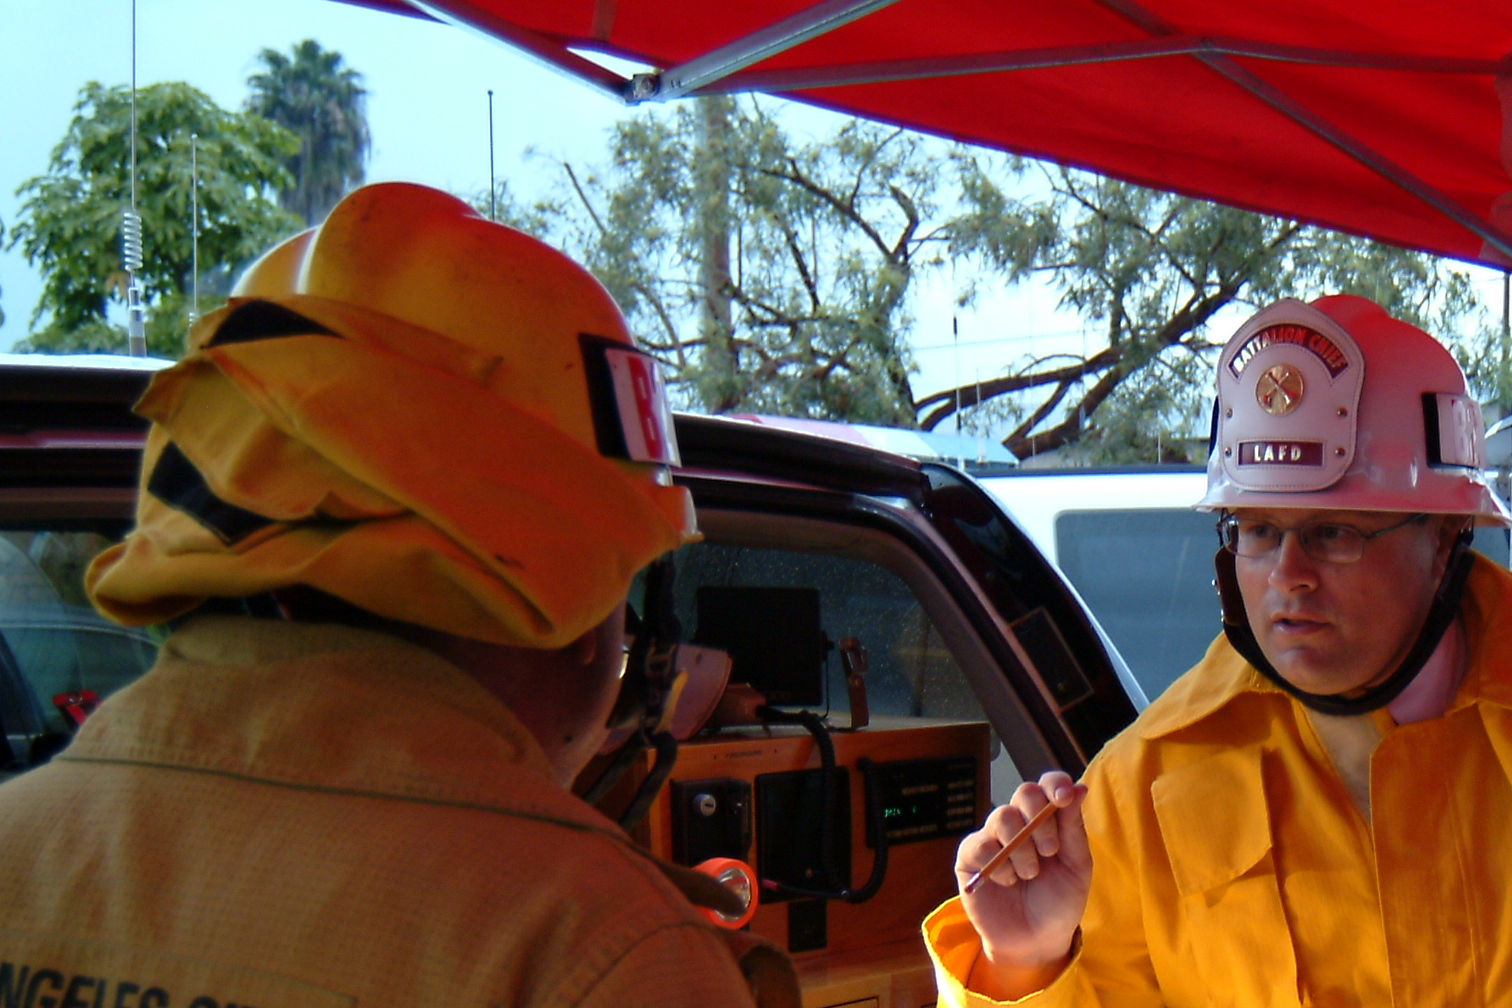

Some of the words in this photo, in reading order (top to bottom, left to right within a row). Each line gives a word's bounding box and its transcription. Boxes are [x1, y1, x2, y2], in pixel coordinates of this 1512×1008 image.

[1233, 326, 1307, 373] BATTALION
[1309, 334, 1348, 369] CHIEF
[1253, 445, 1302, 462] LAFD
